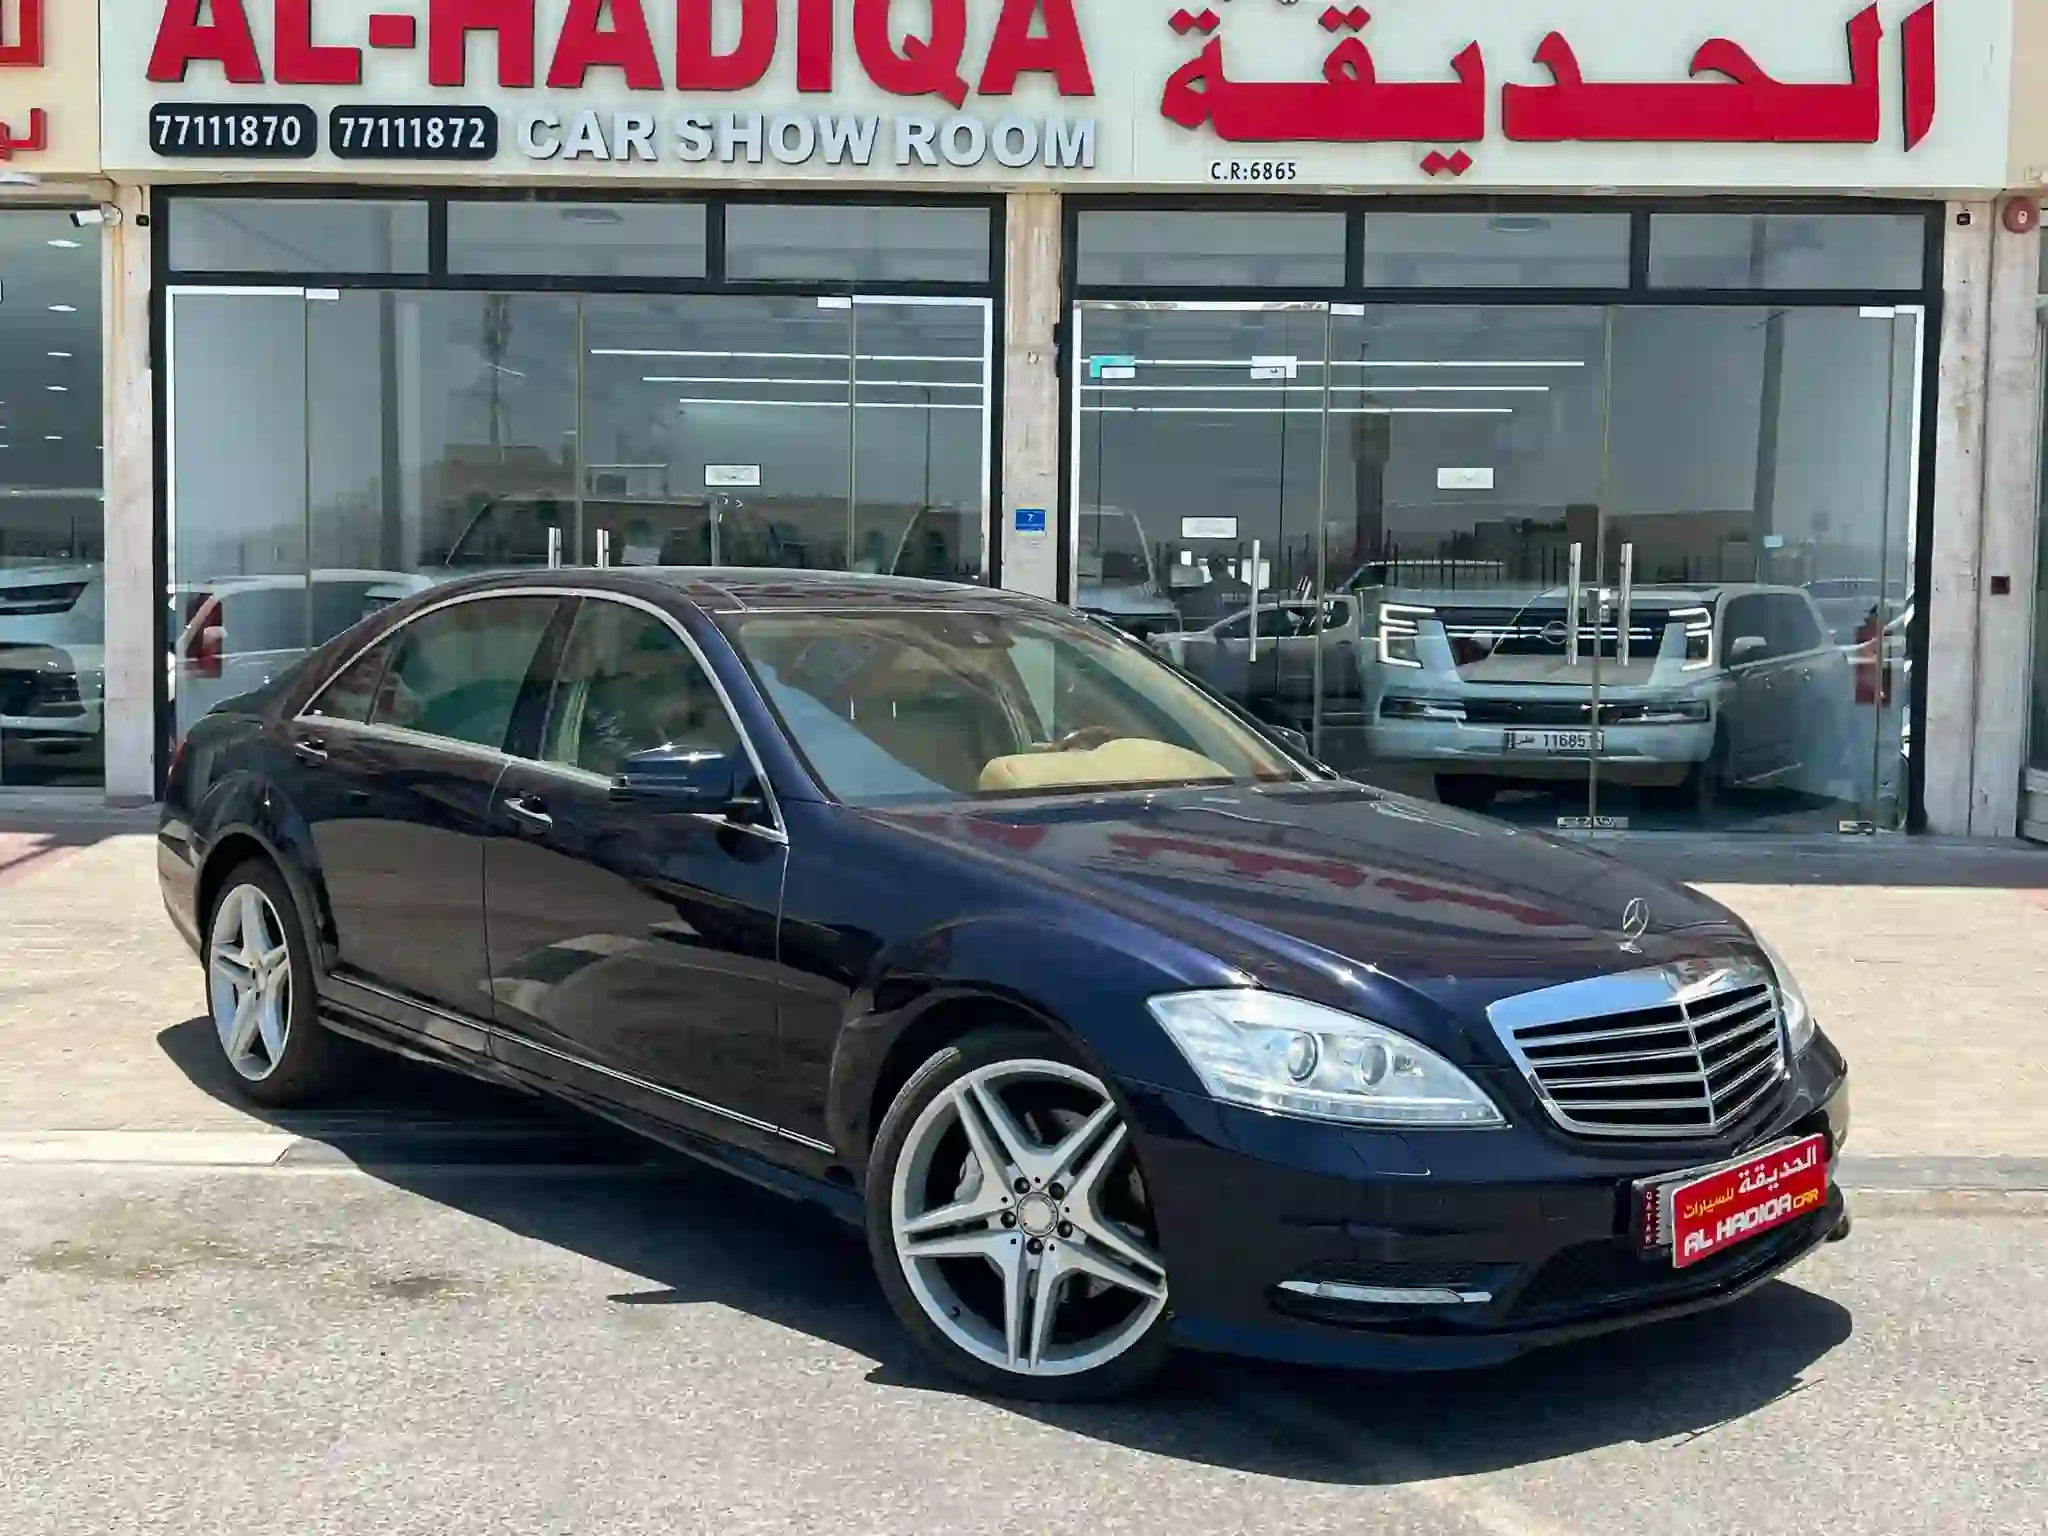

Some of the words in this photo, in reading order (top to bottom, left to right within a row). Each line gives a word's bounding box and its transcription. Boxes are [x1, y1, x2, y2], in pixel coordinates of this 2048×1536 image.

[146, 0, 1095, 109] AL-HADIQA
[1160, 0, 1936, 177] الحديقة
[154, 113, 302, 150] 77111870
[338, 115, 486, 150] 77111872
[516, 109, 657, 161] CAR
[674, 112, 880, 165] SHOW
[894, 113, 1096, 168] ROOM
[1211, 161, 1297, 180] C.R:6865
[1738, 1145, 1816, 1193] الحديقة
[1683, 1187, 1734, 1219] للسيارات
[1684, 1229, 1713, 1256] AL
[1793, 1188, 1819, 1208] CAR
